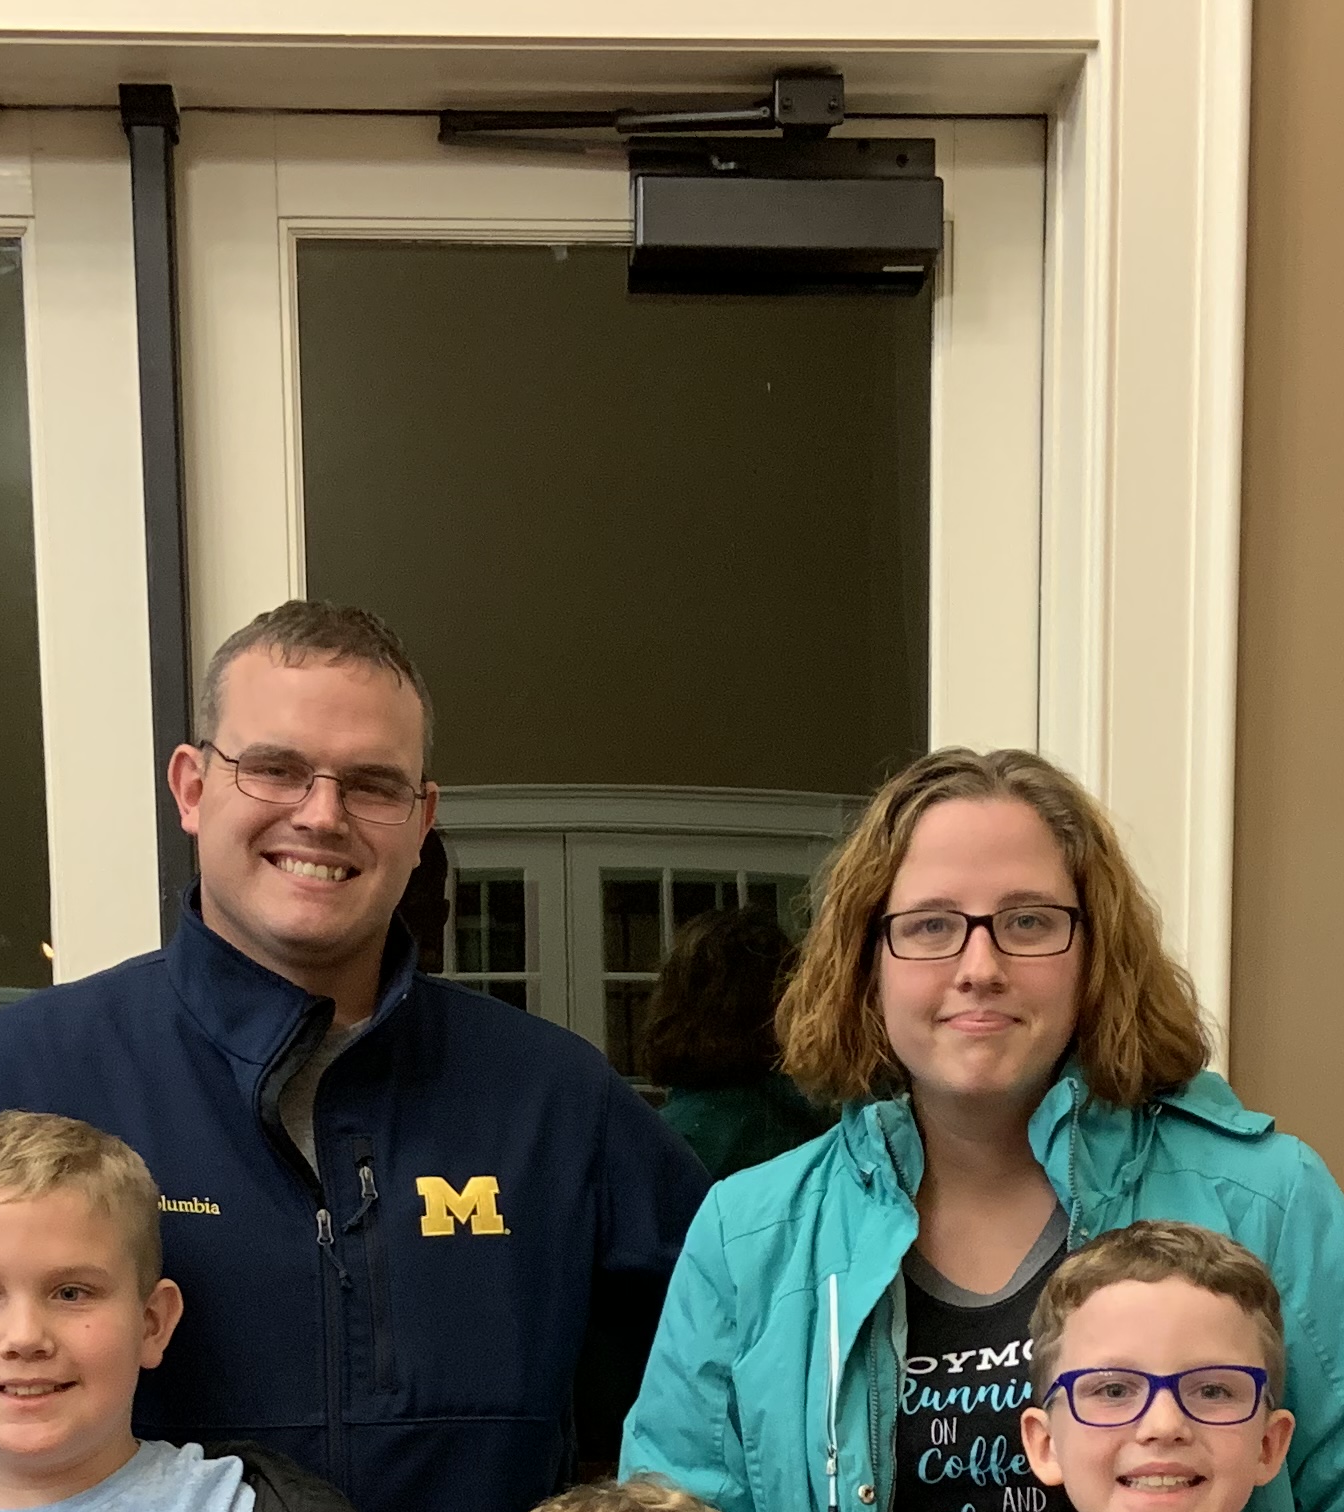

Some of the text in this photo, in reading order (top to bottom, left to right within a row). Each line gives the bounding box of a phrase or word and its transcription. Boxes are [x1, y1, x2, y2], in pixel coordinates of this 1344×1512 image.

[158, 1194, 221, 1215] lumbia
[416, 1176, 503, 1237] M
[930, 1418, 957, 1446] ON
